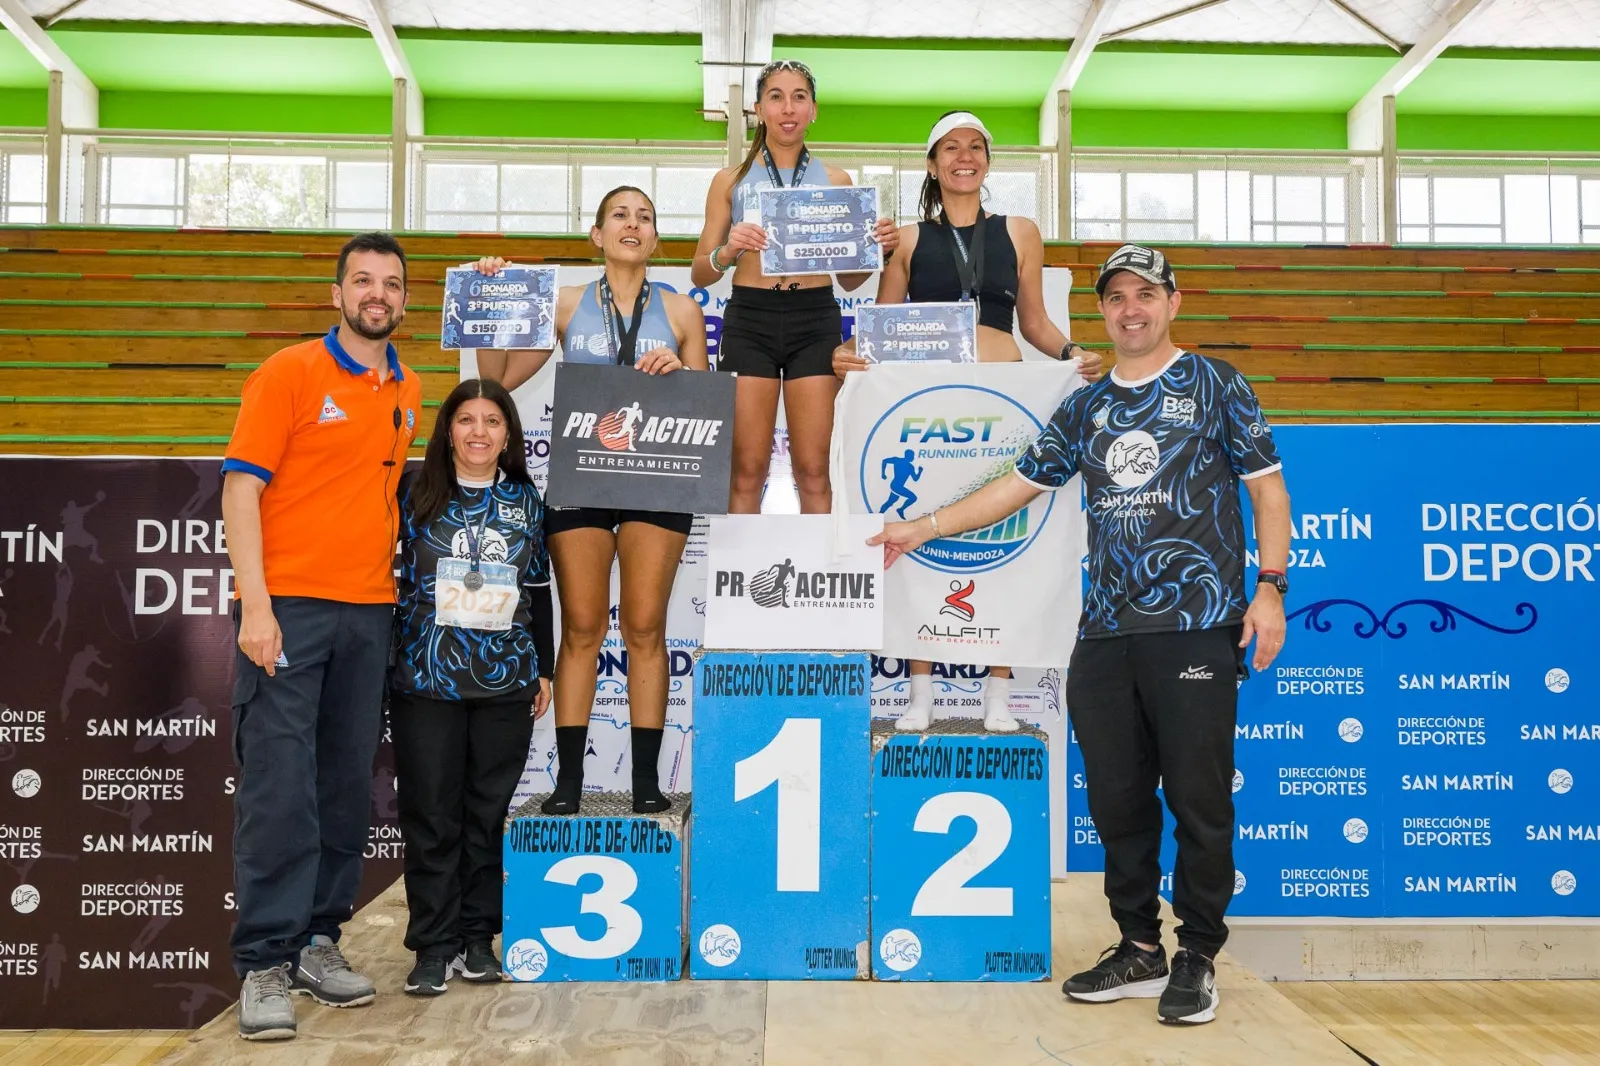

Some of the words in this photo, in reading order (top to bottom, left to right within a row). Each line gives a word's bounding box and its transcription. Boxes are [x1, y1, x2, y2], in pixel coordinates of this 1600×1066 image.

[801, 205, 850, 215] BONARDA
[800, 222, 854, 234] PUESTO
[794, 246, 849, 257] $250.000
[482, 284, 529, 293] BONARDA
[482, 301, 530, 312] PUESTO
[487, 312, 508, 320] 42K
[896, 322, 948, 332] BONARDA
[899, 340, 950, 351] PUESTO
[906, 351, 928, 359] 42K
[638, 416, 723, 446] ACTIVE
[899, 416, 1003, 443] FAST
[918, 448, 977, 459] RUNNING
[981, 447, 1017, 457] TEAM
[578, 456, 701, 471] ENTRENAMIENTO
[1101, 495, 1121, 509] SAN
[1124, 489, 1173, 506] MARTÍN
[1113, 508, 1157, 518] MENDOZA
[1422, 497, 1600, 532] DIRECCIÓ
[0, 523, 63, 563] TÍN
[795, 572, 875, 599] ACTIVE
[443, 587, 512, 614] 2027
[1276, 665, 1345, 678] DIRECCIÓN
[1347, 668, 1364, 678] DE
[777, 664, 794, 696] DE
[797, 664, 865, 696] DEPORTES
[1398, 674, 1434, 690] SAN
[1441, 671, 1510, 690] MARTÍN
[1277, 681, 1364, 695] DEPORTES
[880, 698, 890, 706] DE
[947, 698, 959, 706] DE
[961, 698, 981, 706] 2026
[27, 711, 46, 723] DE
[1398, 715, 1466, 728] DIRECCIÓN
[1468, 718, 1485, 728] DE
[86, 719, 128, 736] SAN
[136, 715, 216, 736] MARTÍN
[1235, 721, 1304, 740] MARTÍN
[1520, 725, 1556, 740] SAN
[1398, 731, 1486, 745] DEPORTES
[881, 738, 951, 778] DIRECCIÓN
[955, 746, 973, 779] DE
[975, 746, 1044, 780] DEPORTES
[83, 767, 162, 780] DIRECCIÓN
[165, 768, 184, 780] DE
[1279, 766, 1347, 779] DIRECCIÓN
[1350, 768, 1366, 779] DE
[1401, 775, 1438, 790] SAN
[1444, 771, 1513, 790] MARTÍN
[82, 784, 184, 800] DEPORTES
[1279, 782, 1367, 796] DEPORTES
[734, 718, 821, 892] 1
[1403, 816, 1472, 828] DIRECCIÓN
[1474, 818, 1491, 828] DE
[22, 827, 42, 838] DE
[585, 821, 602, 853] DE
[1239, 821, 1309, 840] MARTÍN
[1526, 825, 1562, 841] SAN
[82, 834, 124, 852] SAN
[132, 831, 213, 852] MARTÍN
[1403, 831, 1492, 846] DEPORTES
[911, 791, 1014, 917] 2
[1281, 867, 1350, 880] DIRECCIÓN
[1352, 869, 1369, 880] DE
[81, 882, 161, 896] DIRECCIÓN
[164, 884, 184, 896] DE
[1404, 877, 1440, 892] SAN
[1447, 873, 1517, 892] MARTÍN
[1281, 883, 1370, 898] DEPORTES
[81, 900, 184, 916] DEPORTES
[540, 855, 643, 960] 3
[19, 943, 38, 955] DE
[79, 951, 120, 969] SAN
[128, 948, 209, 969] MARTÍN
[805, 948, 833, 969] PLOTTER
[985, 952, 1012, 973] PLOTTER
[1013, 953, 1047, 974] MUNICIPAL
[616, 958, 643, 979] PTTER
